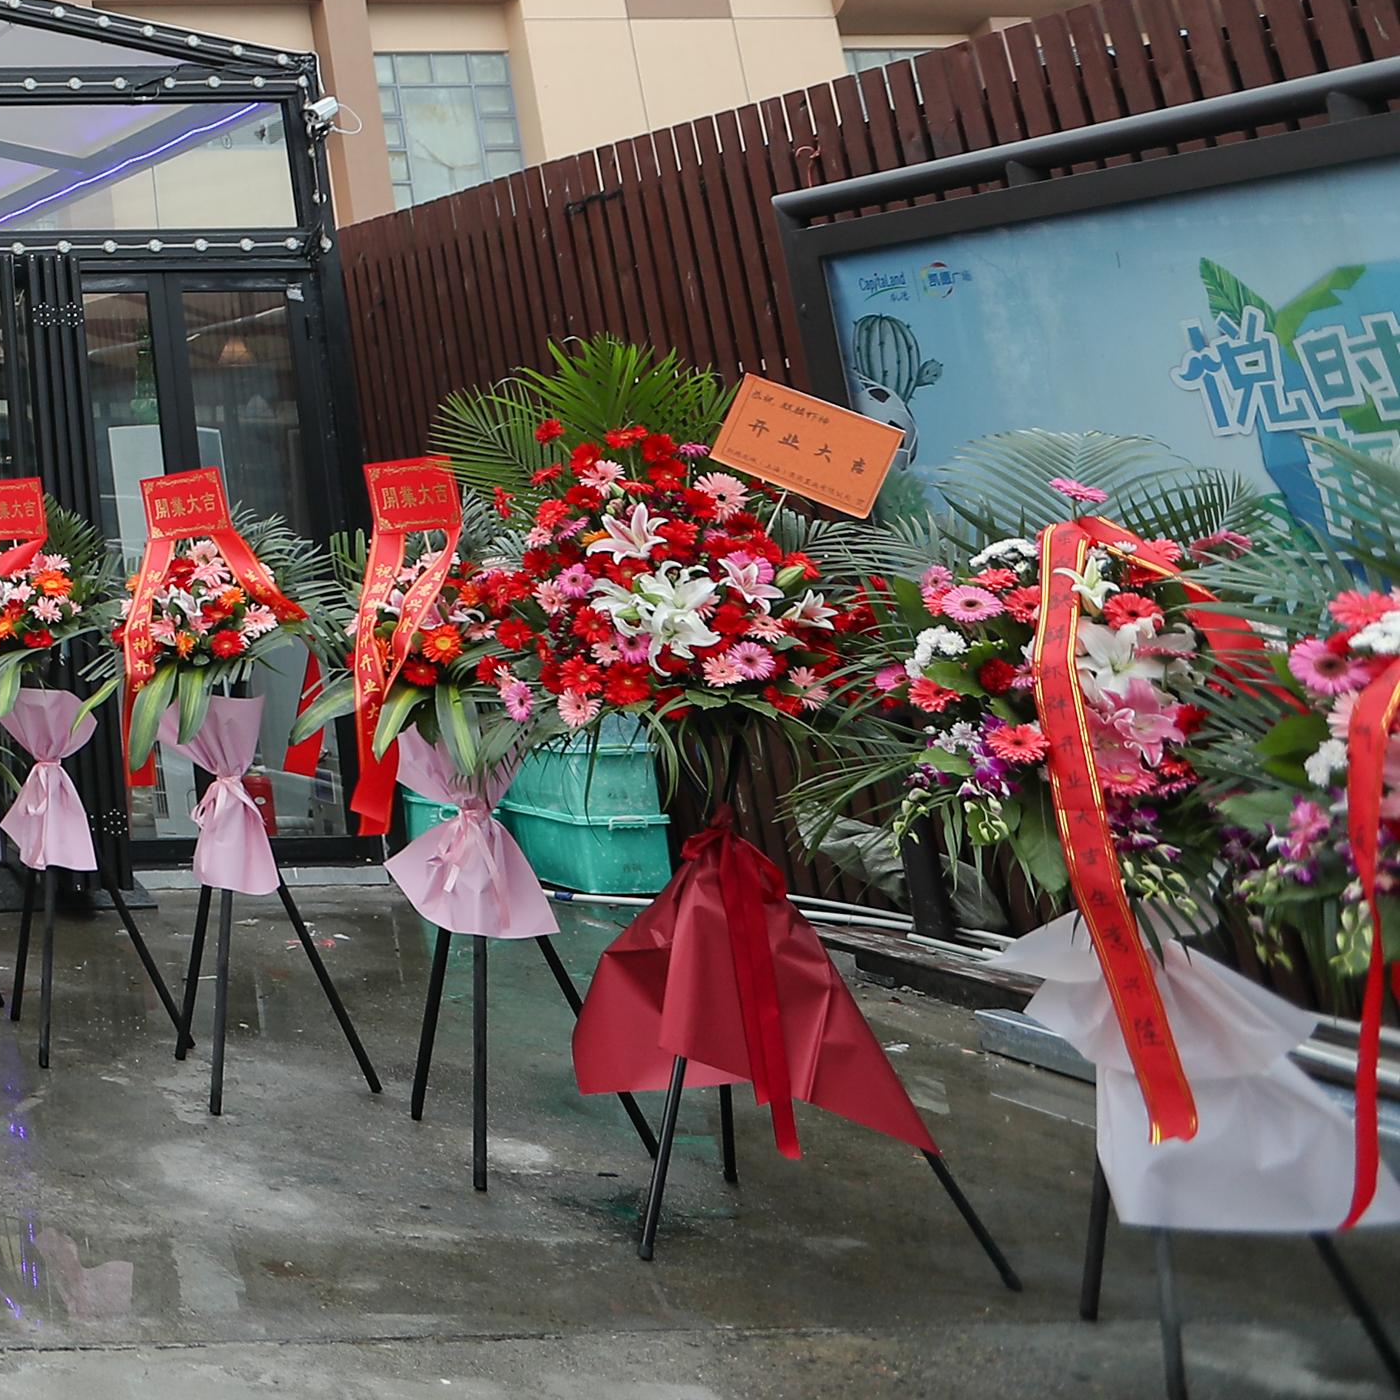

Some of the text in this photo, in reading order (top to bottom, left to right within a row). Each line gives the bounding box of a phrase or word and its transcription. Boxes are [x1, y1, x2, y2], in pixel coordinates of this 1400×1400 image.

[748, 418, 867, 475] 开业大吉
[154, 492, 216, 520] 開業大吉
[381, 483, 449, 510] 開業大吉
